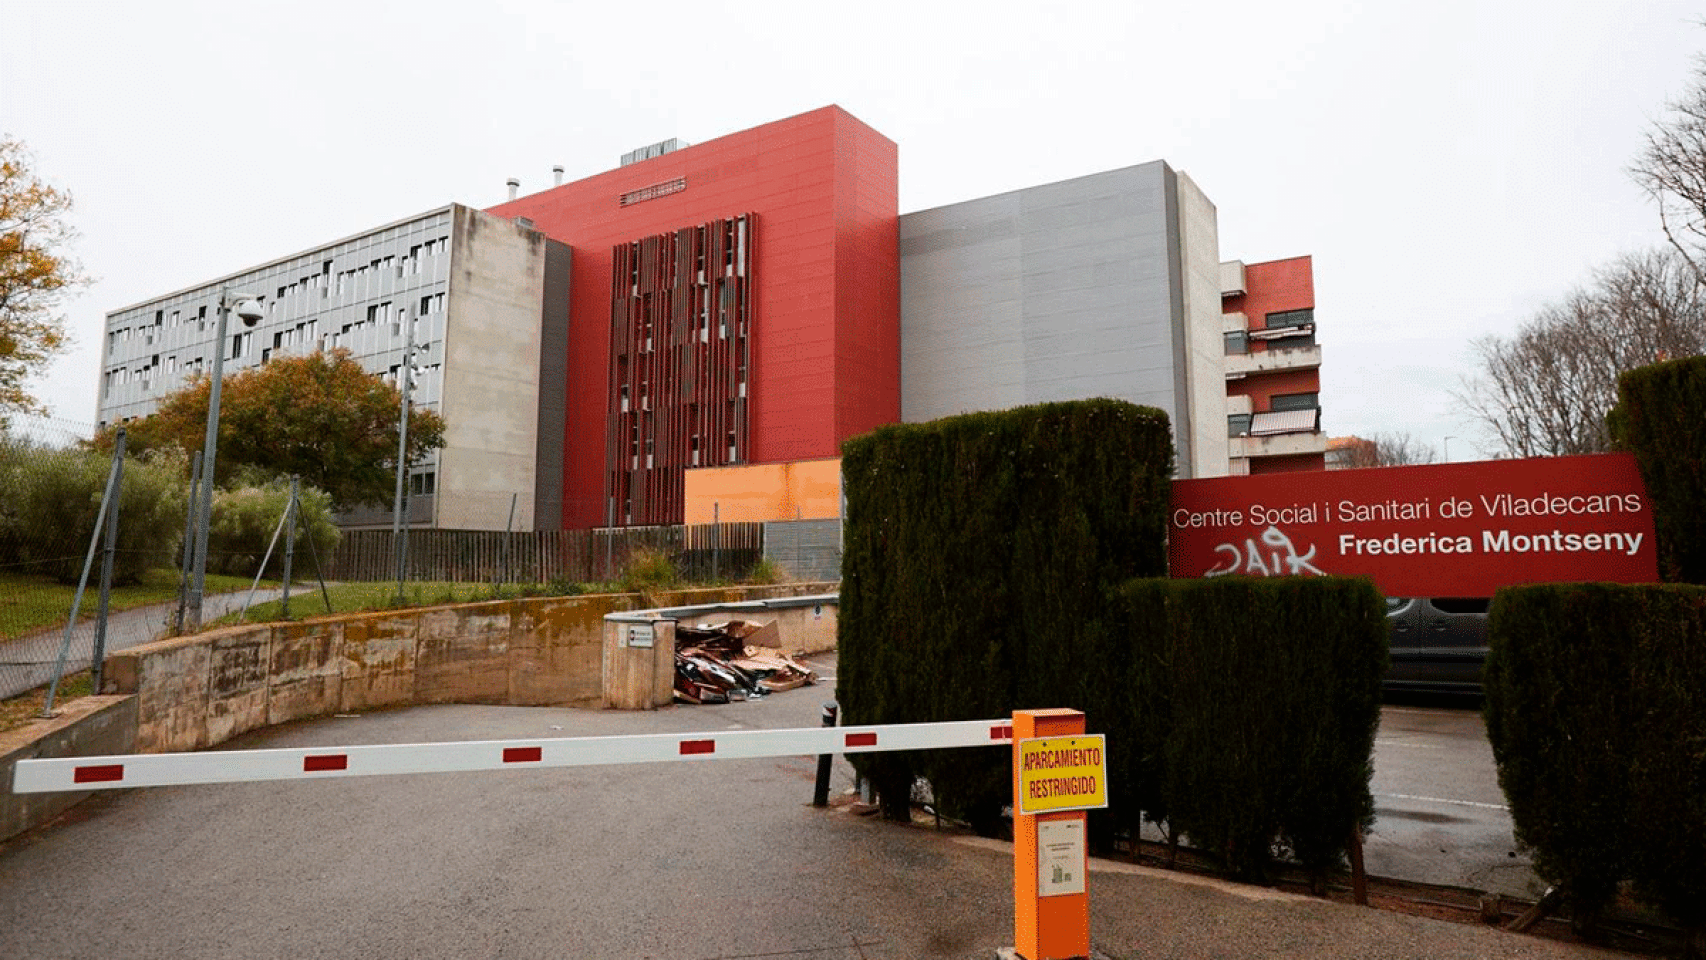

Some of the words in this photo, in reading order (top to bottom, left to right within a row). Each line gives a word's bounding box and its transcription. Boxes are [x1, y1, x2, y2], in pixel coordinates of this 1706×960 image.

[1174, 508, 1243, 529] Centre
[1250, 503, 1317, 525] Social
[1325, 502, 1329, 522] i
[1338, 499, 1430, 521] Sanitari
[1440, 497, 1472, 518] de
[1480, 492, 1641, 517] Viladecans
[1339, 532, 1472, 556] Frederica
[1483, 530, 1643, 557] Montseny
[1024, 748, 1100, 770] APARCAMIENTO
[1029, 776, 1096, 798] RESTRINGIDO
